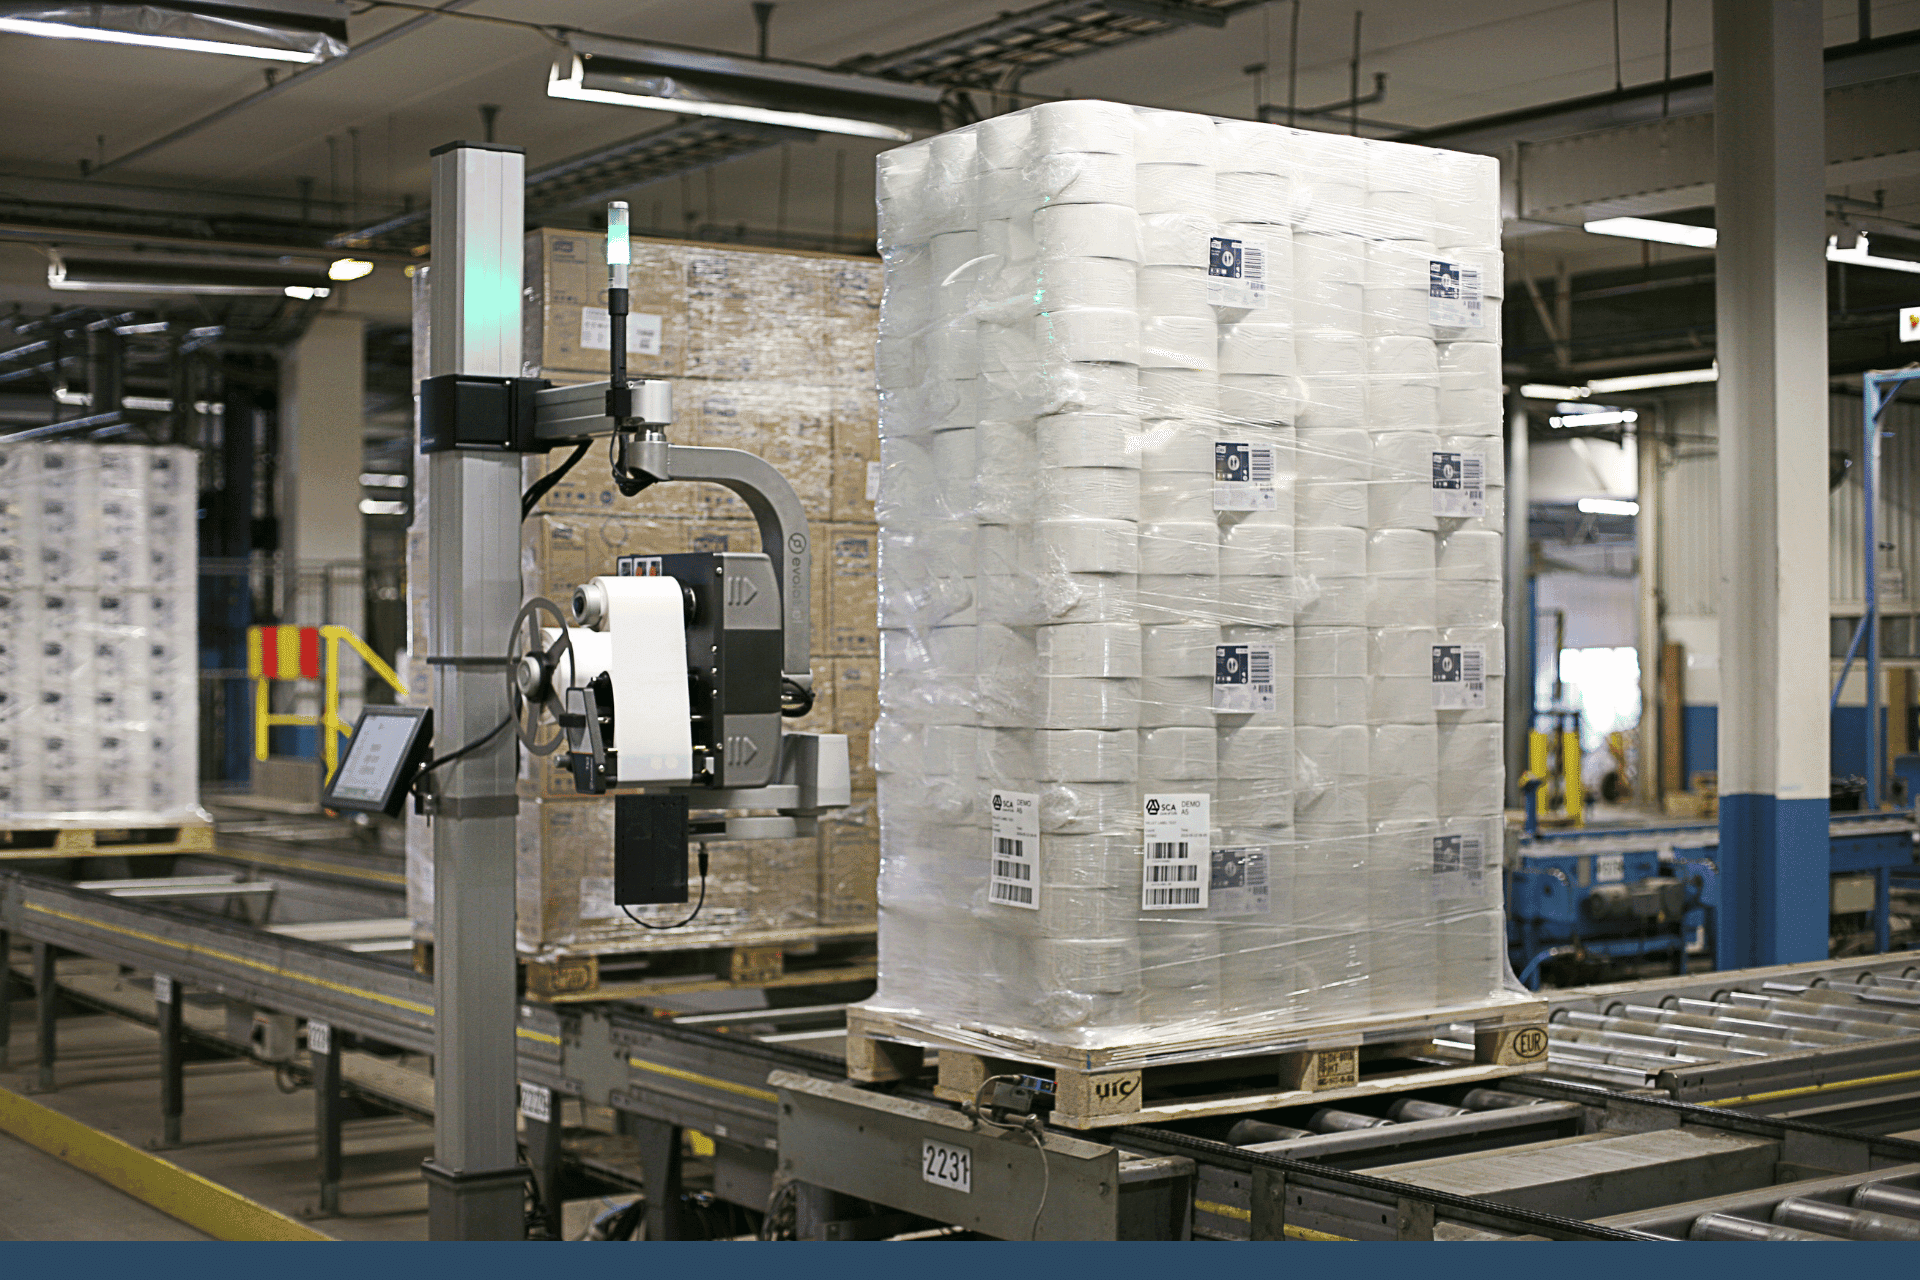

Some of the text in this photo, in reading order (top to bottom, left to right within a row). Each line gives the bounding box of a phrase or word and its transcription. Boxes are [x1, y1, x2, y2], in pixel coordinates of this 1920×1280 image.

[1003, 800, 1013, 808] SCA
[1016, 799, 1031, 807] DEMO
[1181, 800, 1201, 808] DEMO
[1181, 808, 1189, 816] AS
[1520, 1032, 1541, 1053] EUR
[926, 1145, 967, 1185] 2231
